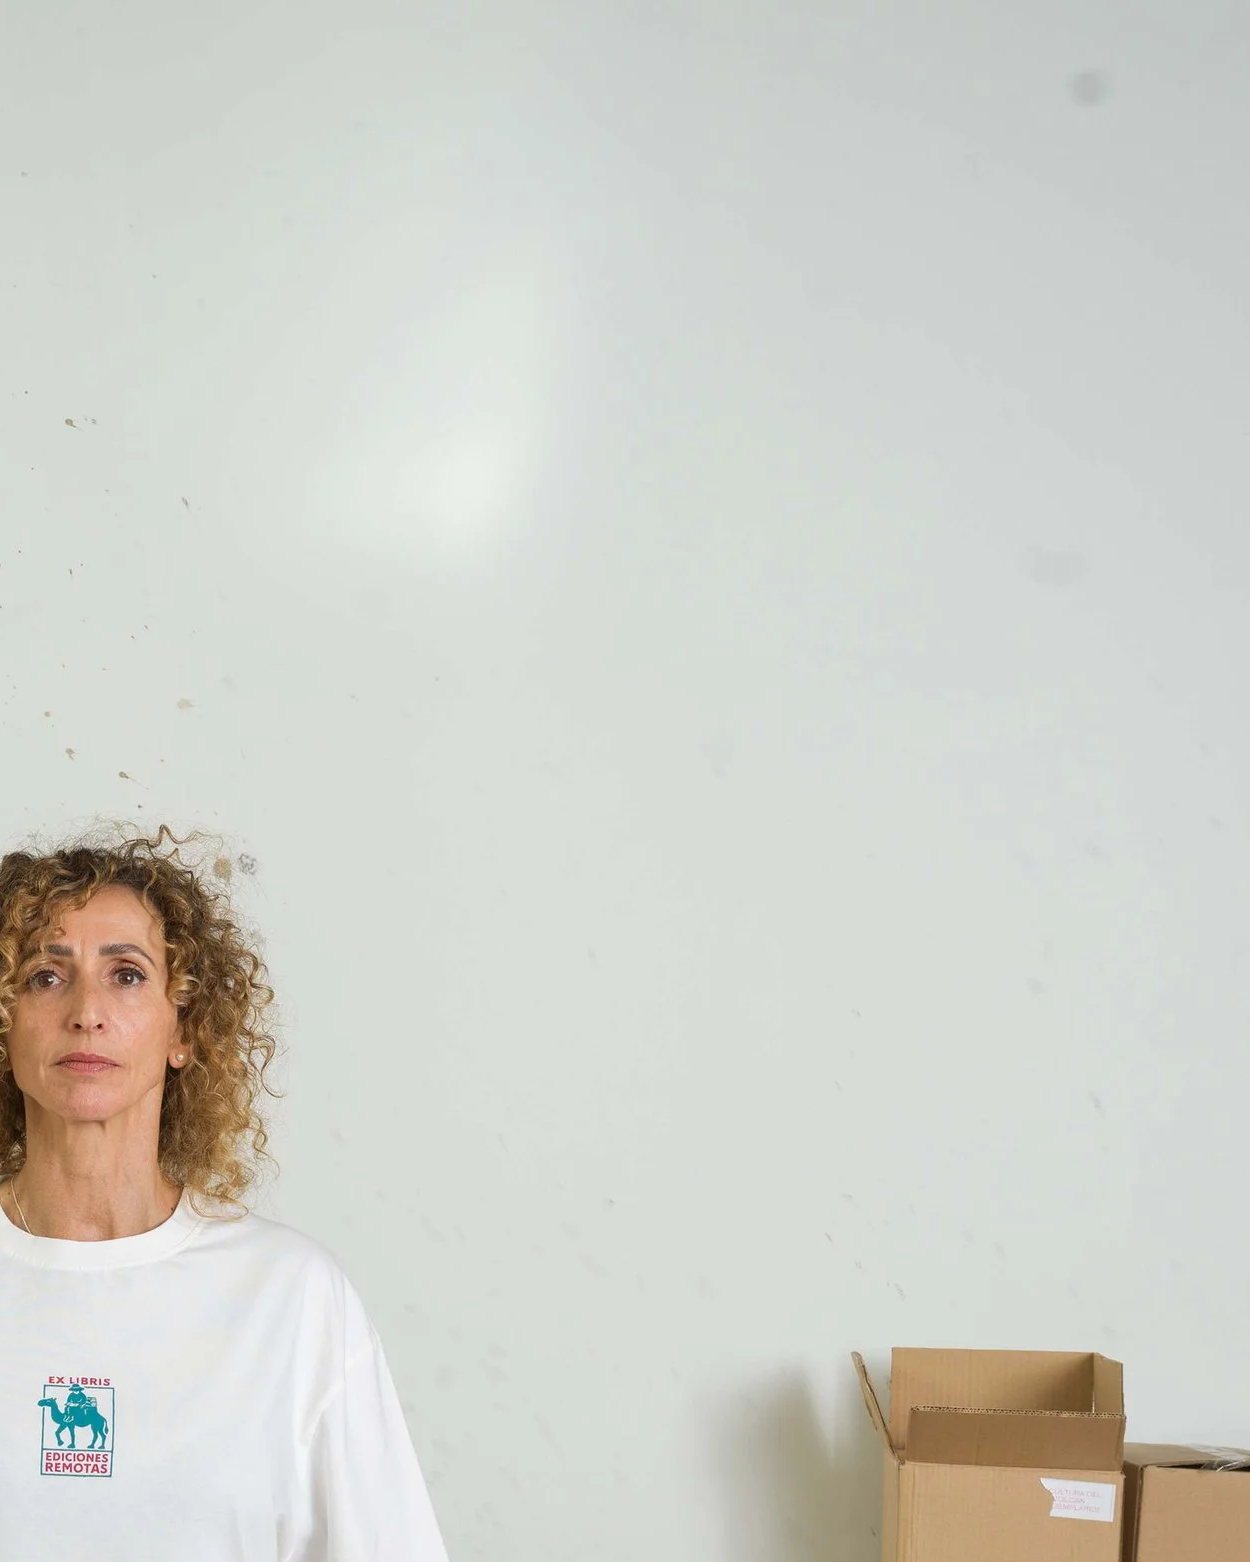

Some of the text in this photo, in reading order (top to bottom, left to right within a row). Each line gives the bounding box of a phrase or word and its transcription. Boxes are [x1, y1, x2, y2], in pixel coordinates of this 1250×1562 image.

[48, 1376, 111, 1386] EX LIBRIS
[45, 1452, 109, 1463] EDICIONES
[45, 1462, 108, 1474] REMOTAS
